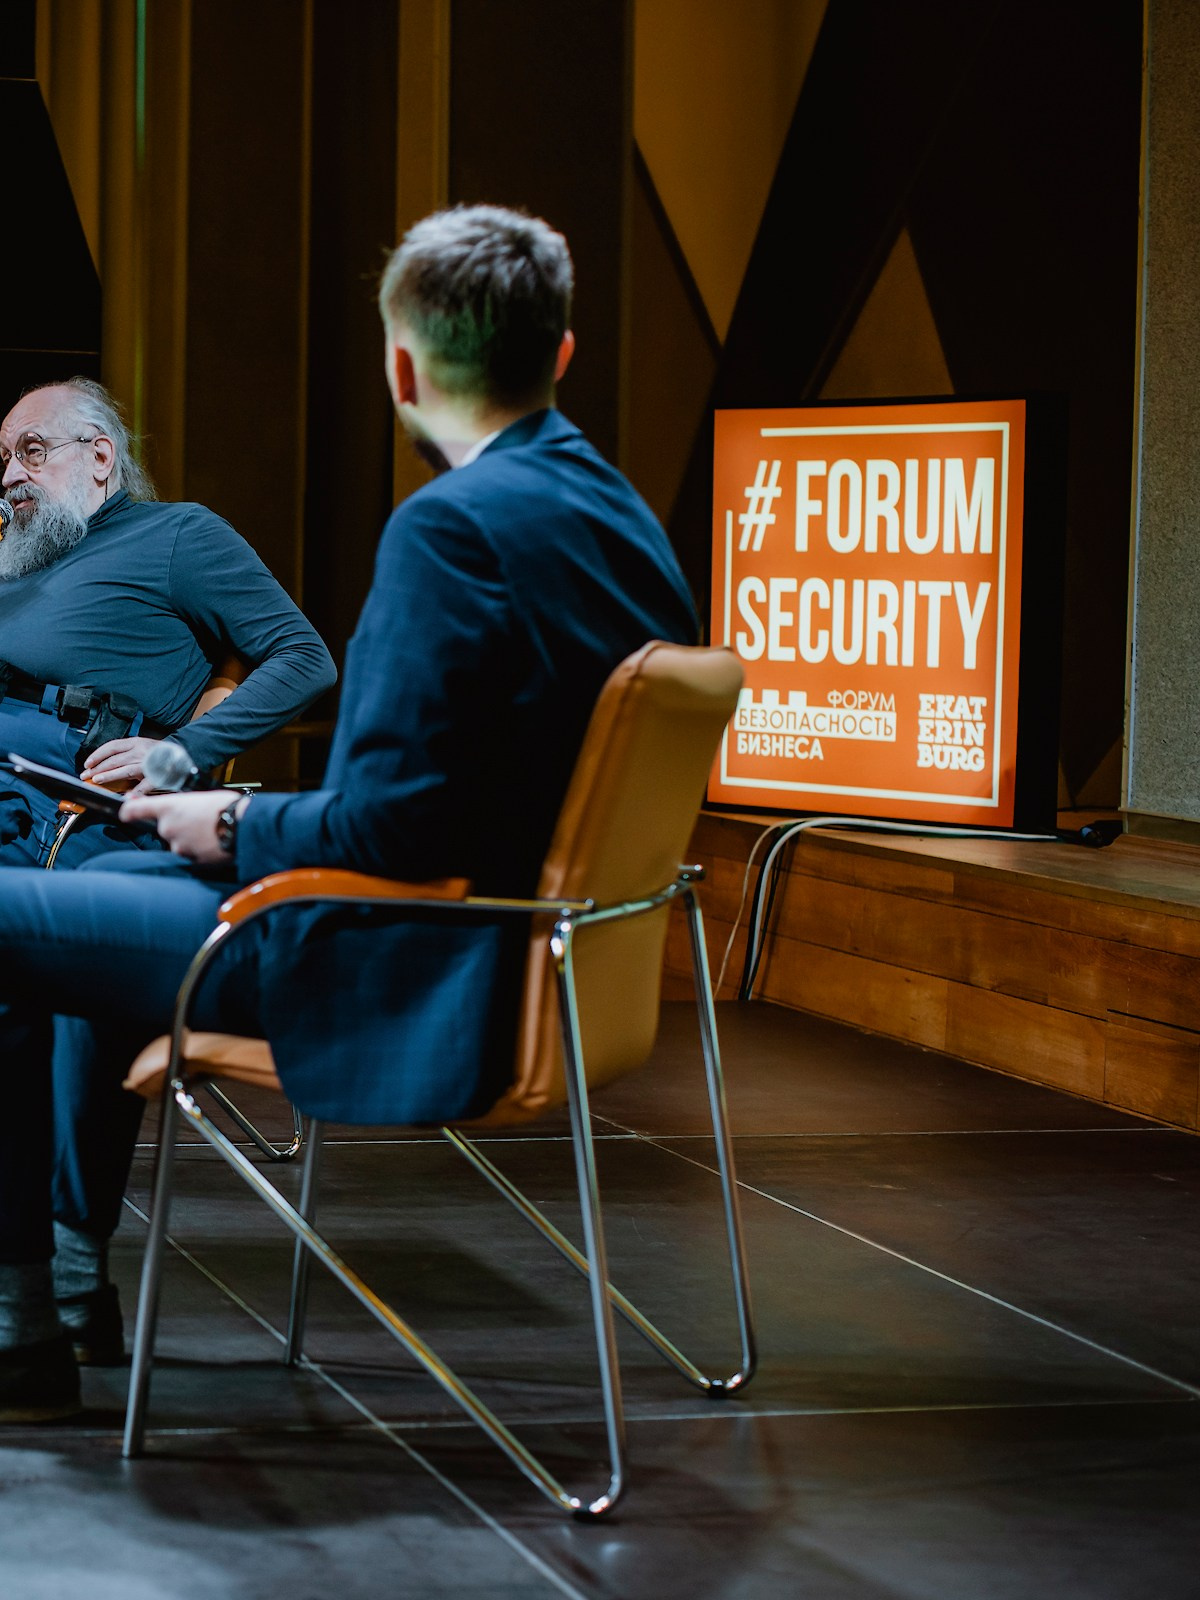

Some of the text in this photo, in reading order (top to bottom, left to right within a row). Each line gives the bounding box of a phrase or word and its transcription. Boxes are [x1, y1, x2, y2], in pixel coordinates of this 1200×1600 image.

[736, 576, 991, 670] SECURITY
[827, 690, 895, 712] ФОРУМ
[918, 693, 987, 721] EKAT
[738, 708, 894, 737] БЕЗОПАСНОСТЬ
[918, 719, 987, 746] ERIN
[737, 732, 824, 761] БИЗНЕСА
[917, 744, 985, 772] BURG
